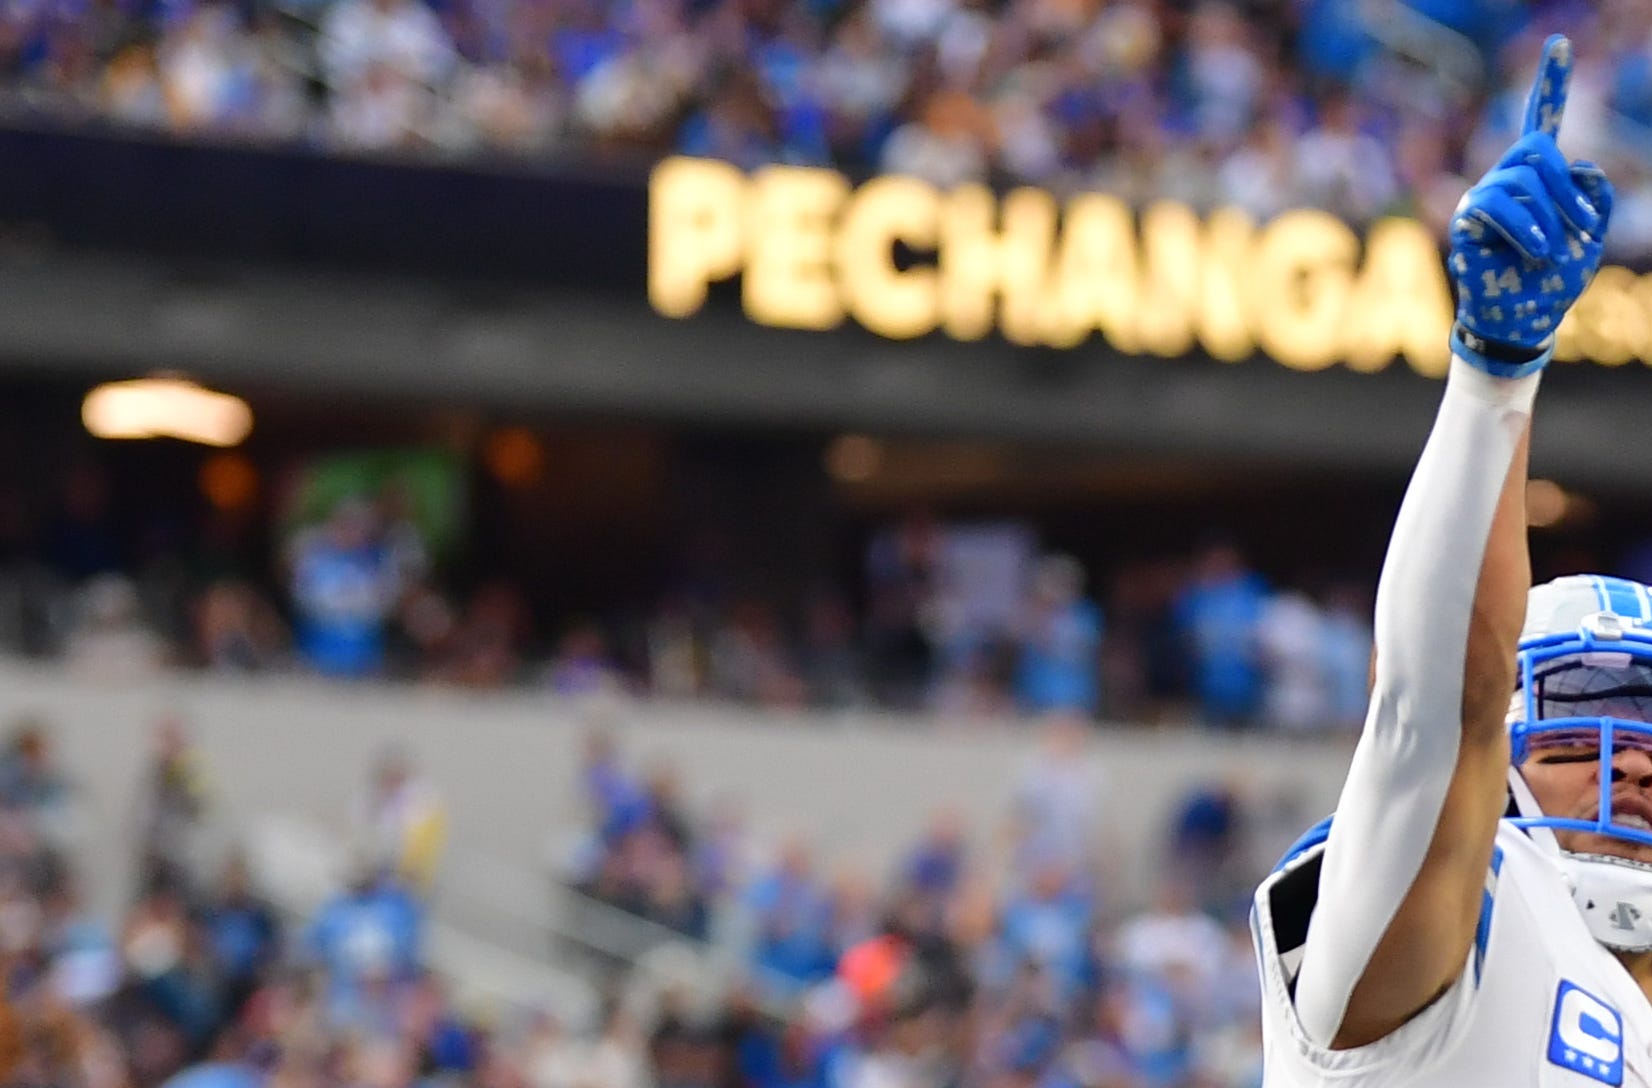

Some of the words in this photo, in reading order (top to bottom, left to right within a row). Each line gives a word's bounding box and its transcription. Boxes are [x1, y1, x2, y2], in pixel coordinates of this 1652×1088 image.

[647, 155, 1453, 378] PECHANGA
[1482, 267, 1522, 297] 14
[1557, 988, 1620, 1063] C
